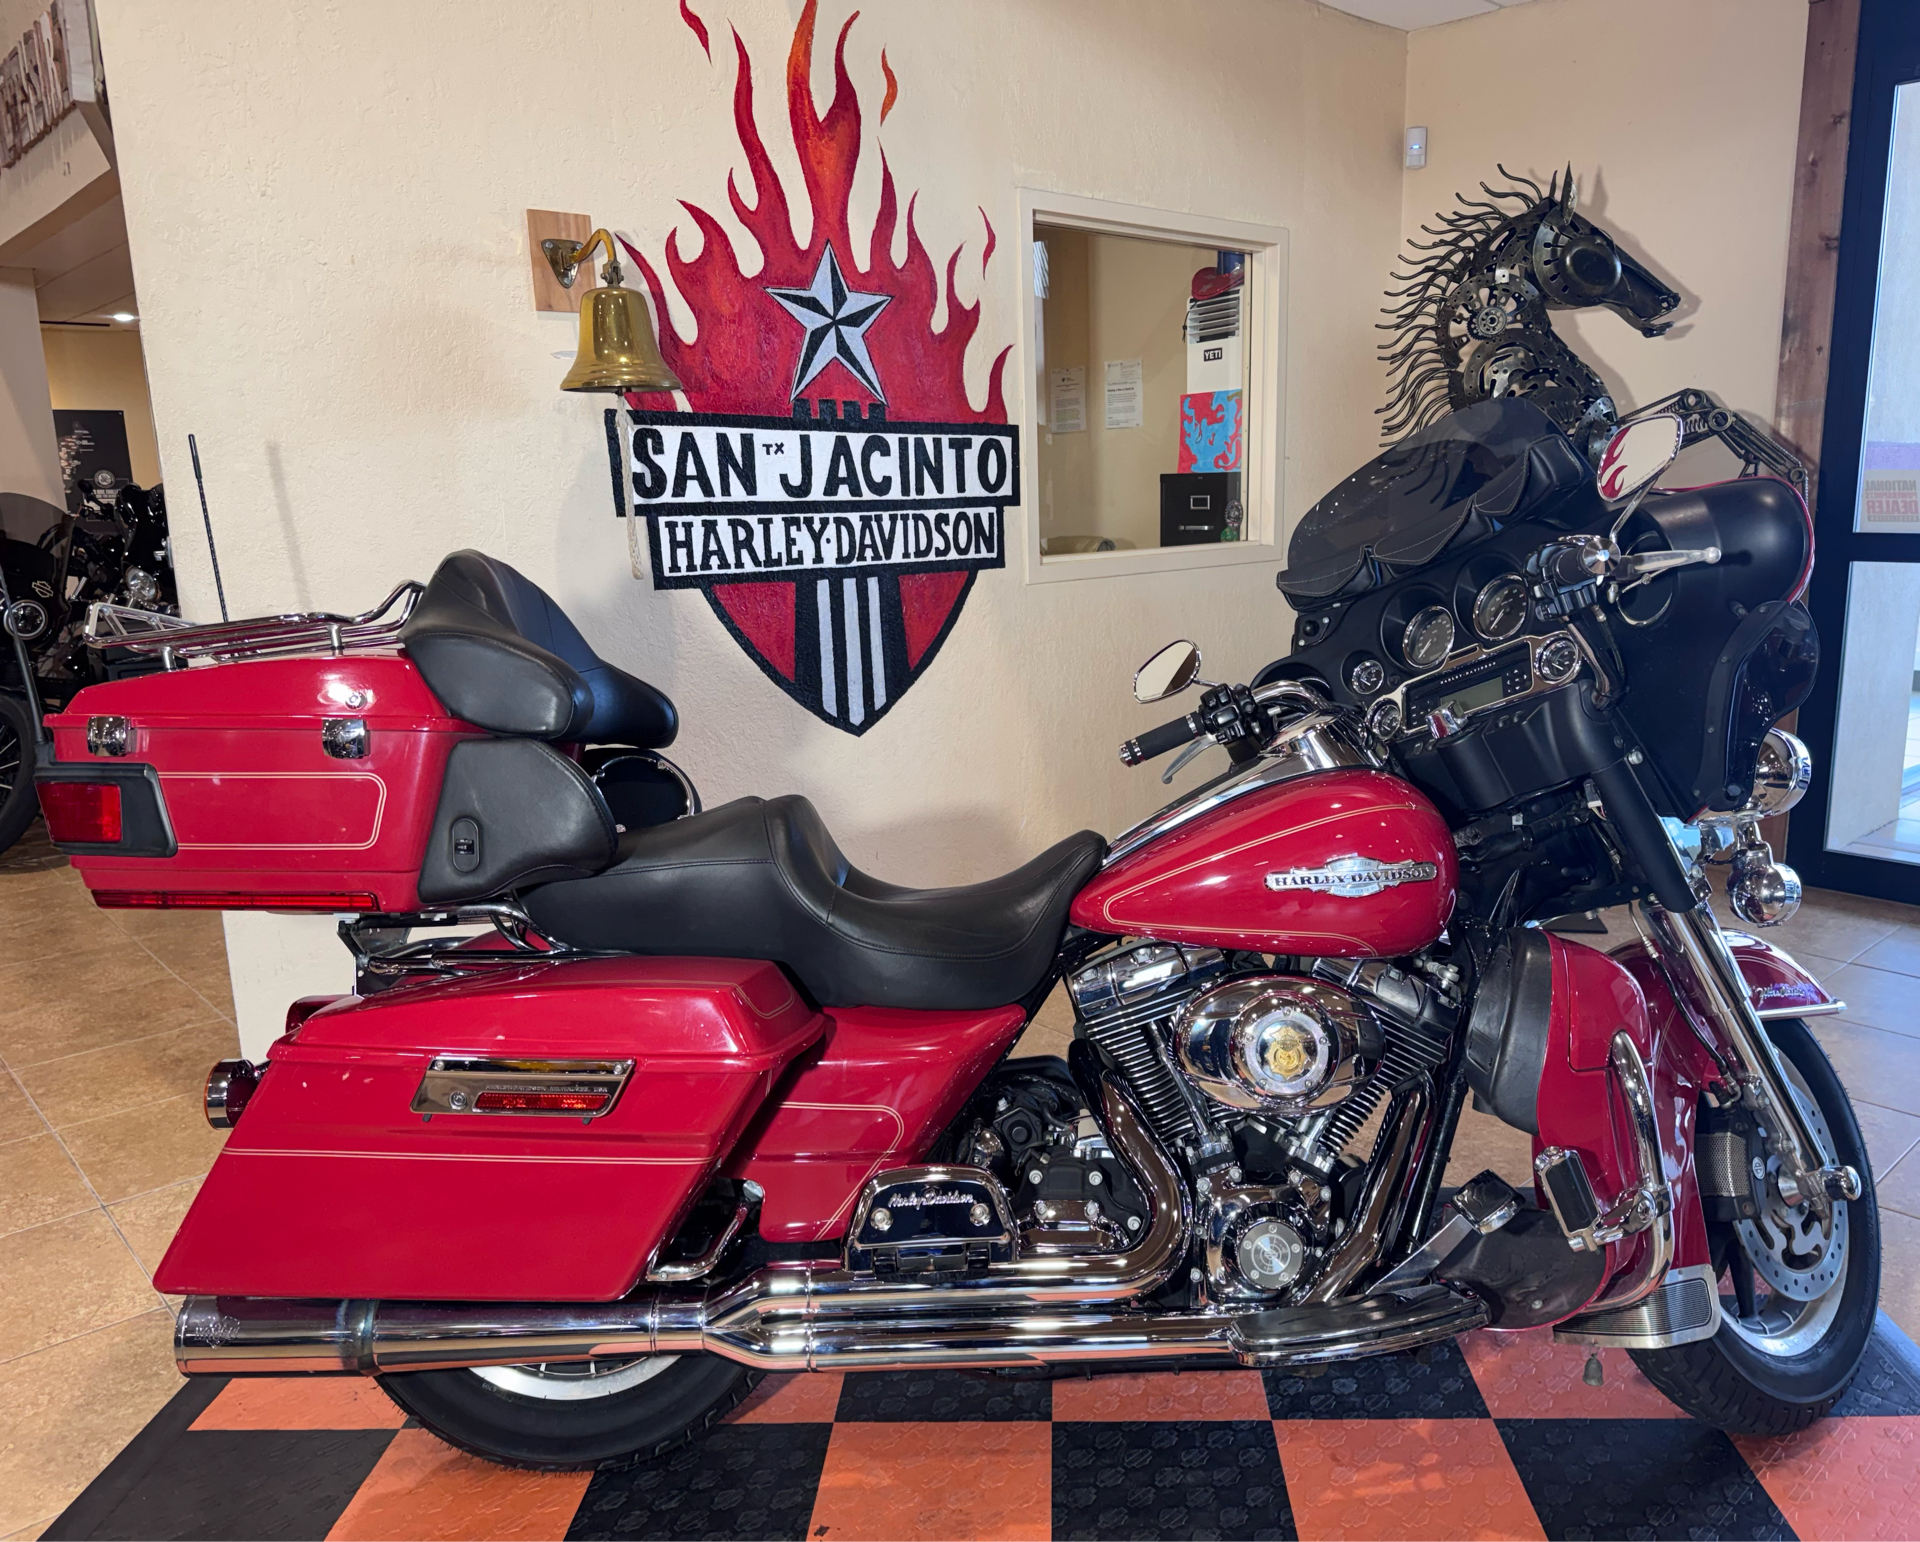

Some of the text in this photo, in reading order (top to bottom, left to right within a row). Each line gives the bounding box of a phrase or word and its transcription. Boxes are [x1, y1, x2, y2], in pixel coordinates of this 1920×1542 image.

[1204, 349, 1222, 360] YETI
[631, 427, 1008, 499] SAN TX JACINTO
[1274, 866, 1431, 887] HARLEY-DAVIDSON
